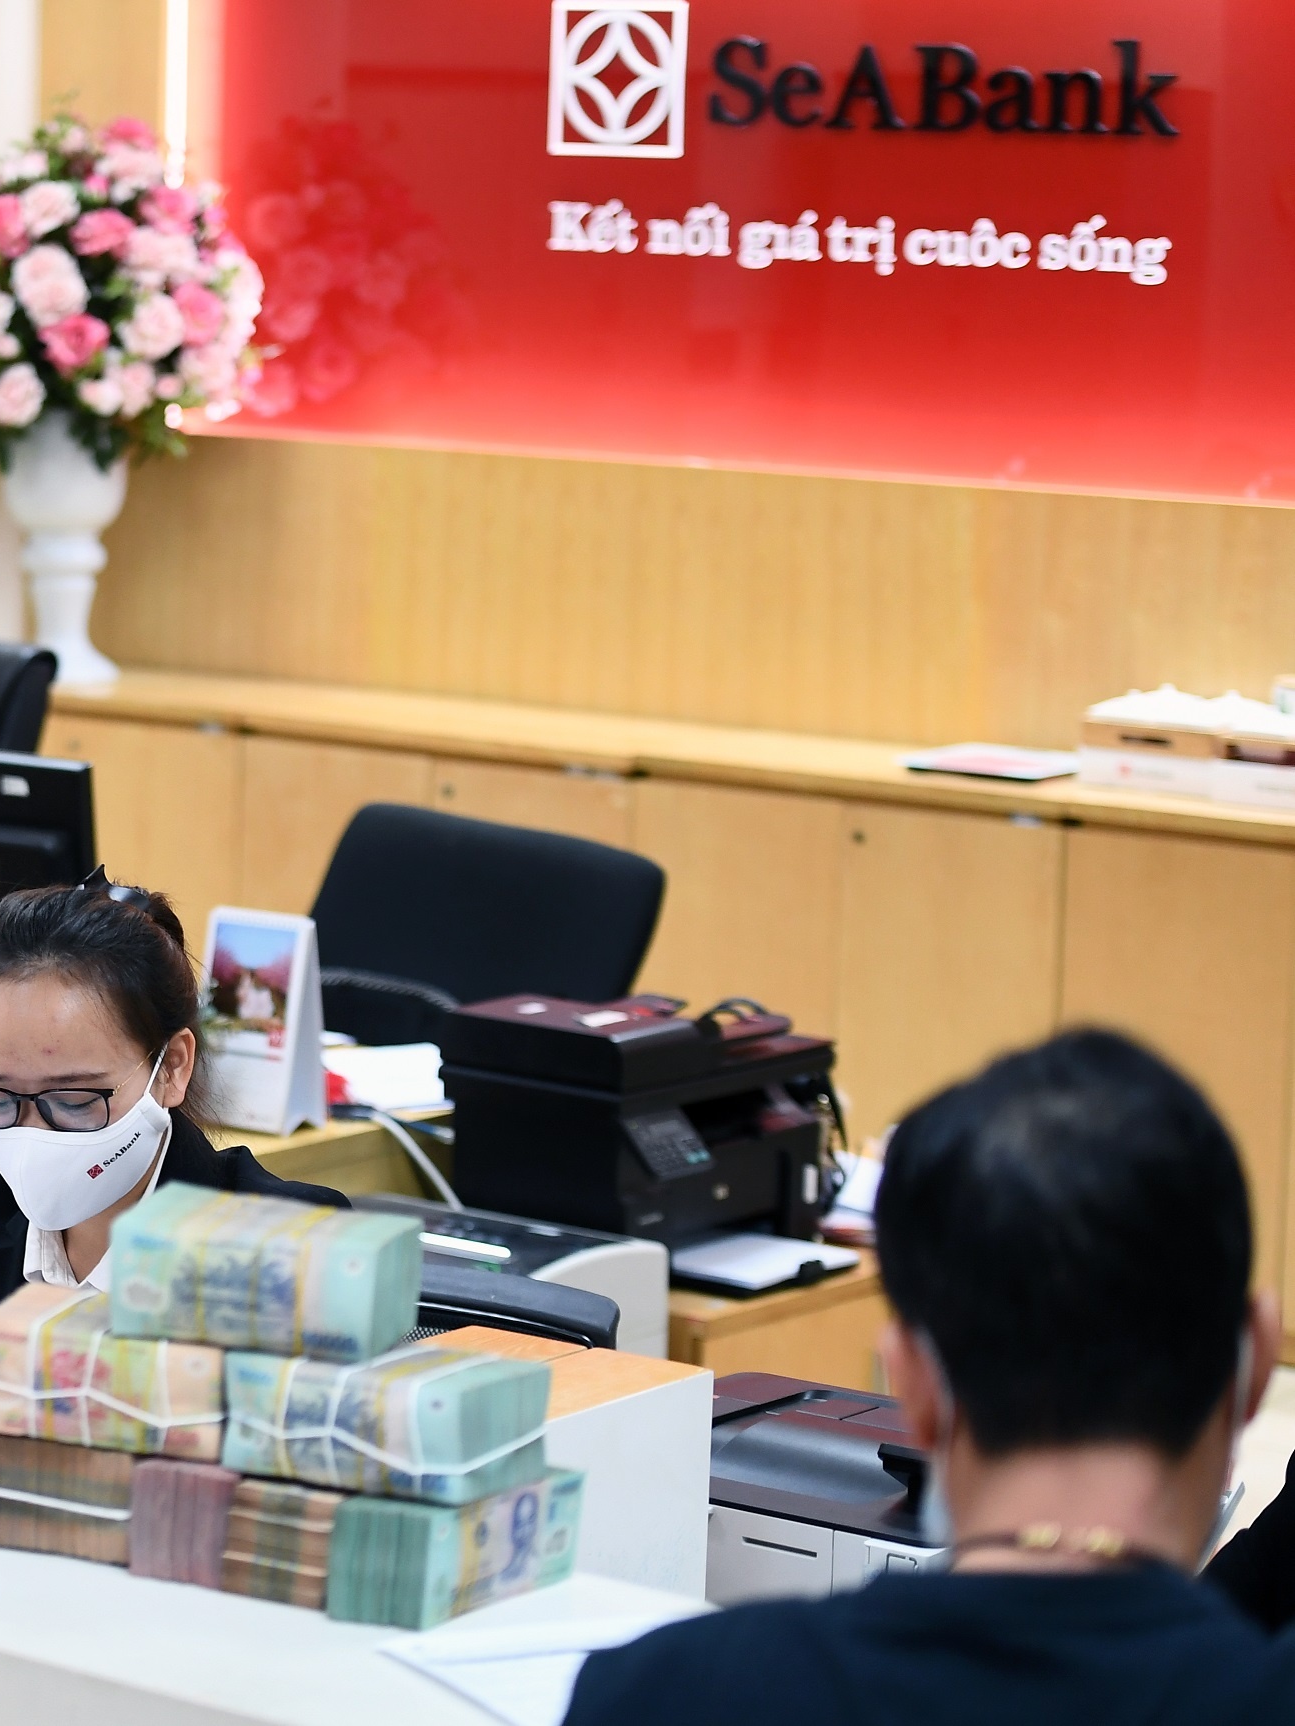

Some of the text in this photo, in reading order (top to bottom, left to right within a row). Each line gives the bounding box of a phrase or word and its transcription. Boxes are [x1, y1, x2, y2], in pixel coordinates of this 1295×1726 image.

[708, 36, 1180, 138] SeABank
[548, 200, 639, 254] Kết
[646, 202, 732, 257] nối
[826, 215, 898, 276] trị
[1037, 214, 1173, 286] sống
[102, 1131, 141, 1168] SeABank
